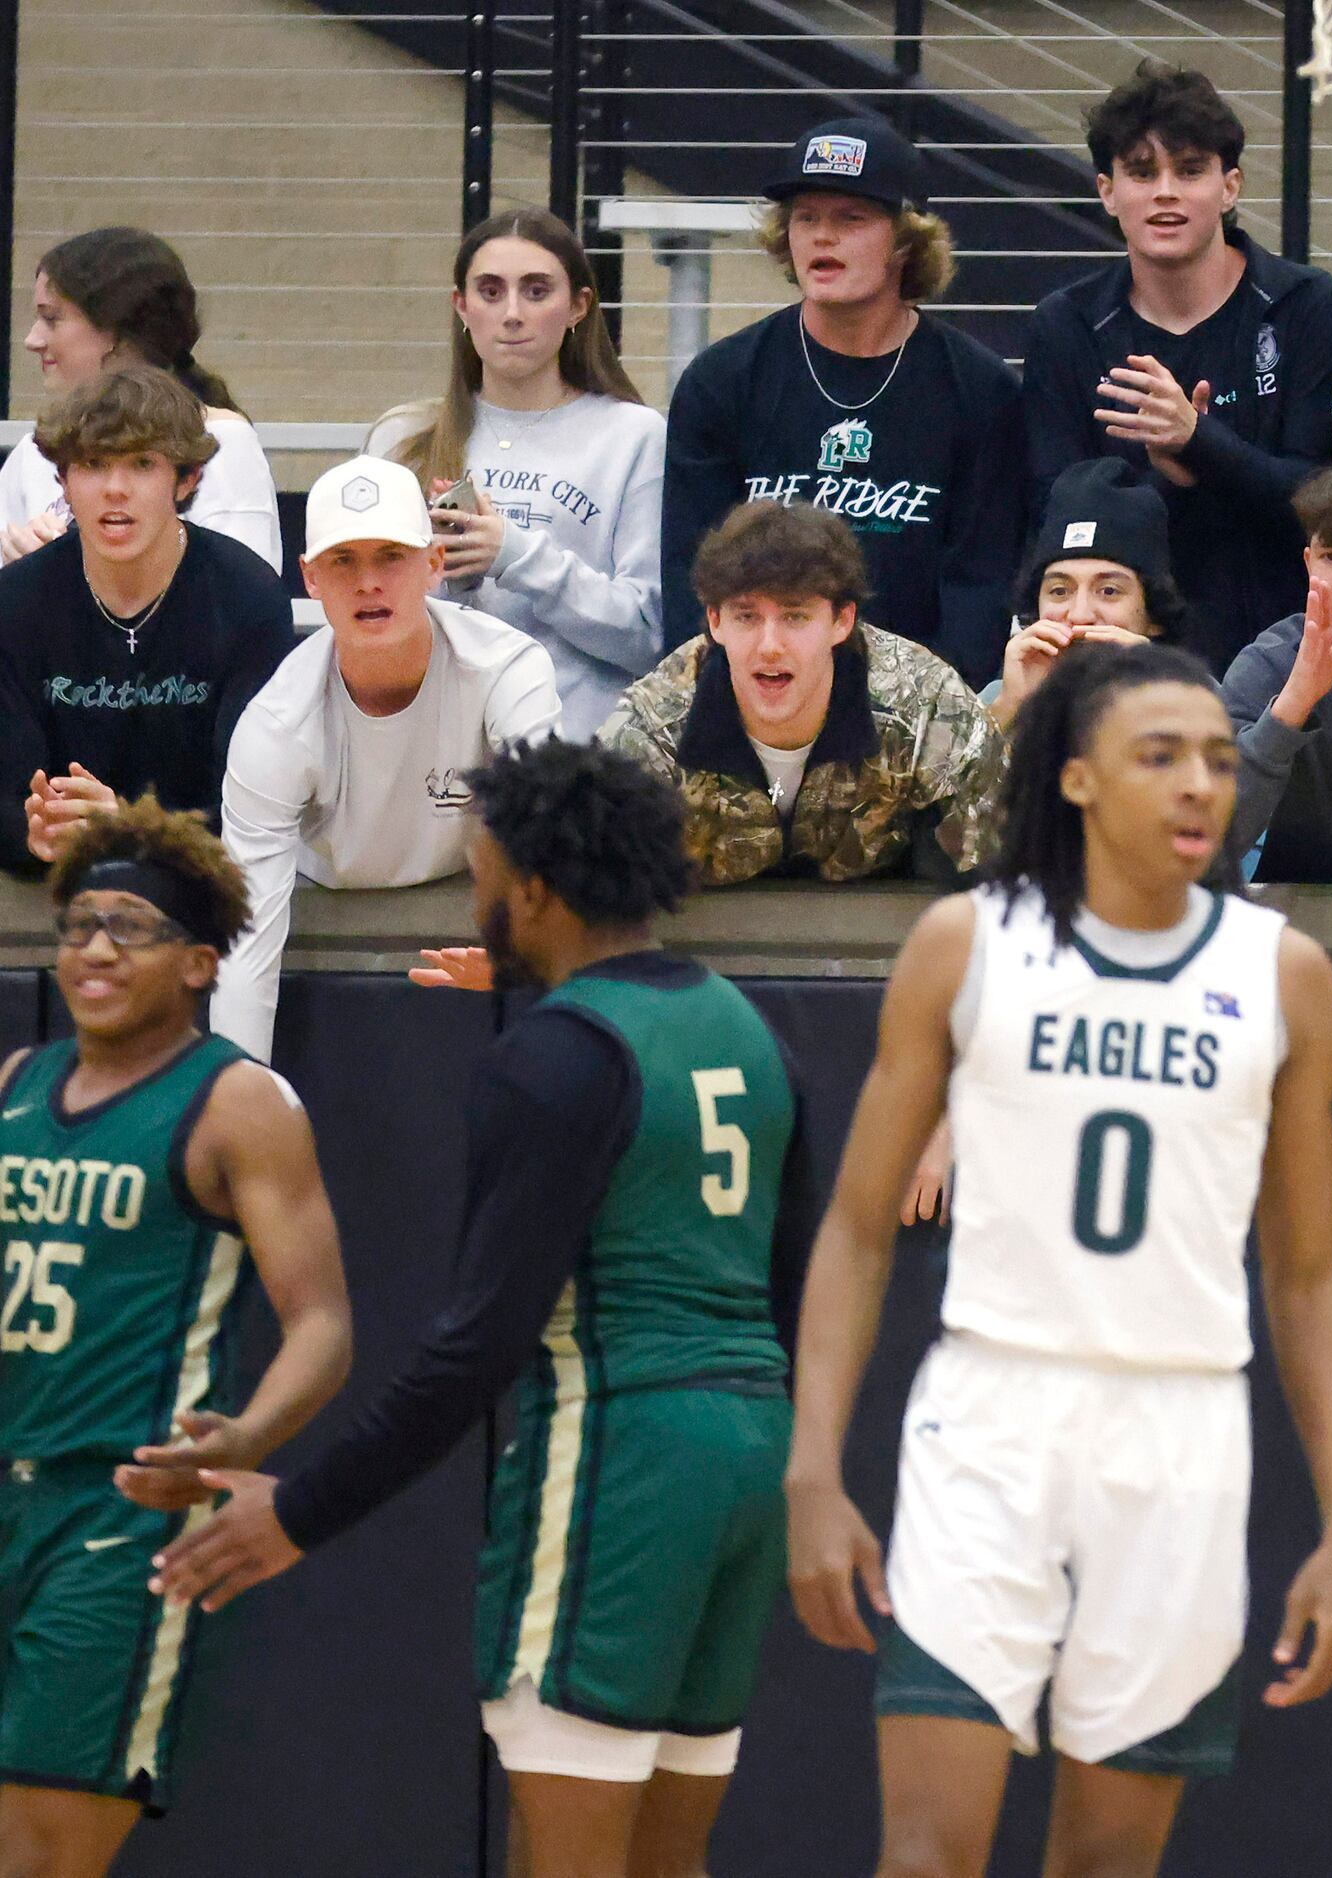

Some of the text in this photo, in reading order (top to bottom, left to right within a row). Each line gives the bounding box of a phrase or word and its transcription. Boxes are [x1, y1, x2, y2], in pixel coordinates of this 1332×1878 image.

[1255, 373, 1277, 396] 12
[484, 468, 548, 492] YORK
[551, 480, 601, 526] CITY
[745, 473, 941, 522] THE RIDGE
[1028, 1013, 1219, 1091] EAGLES
[691, 1066, 751, 1217] 5
[1073, 1108, 1153, 1257] 0
[0, 1239, 86, 1355] 25
